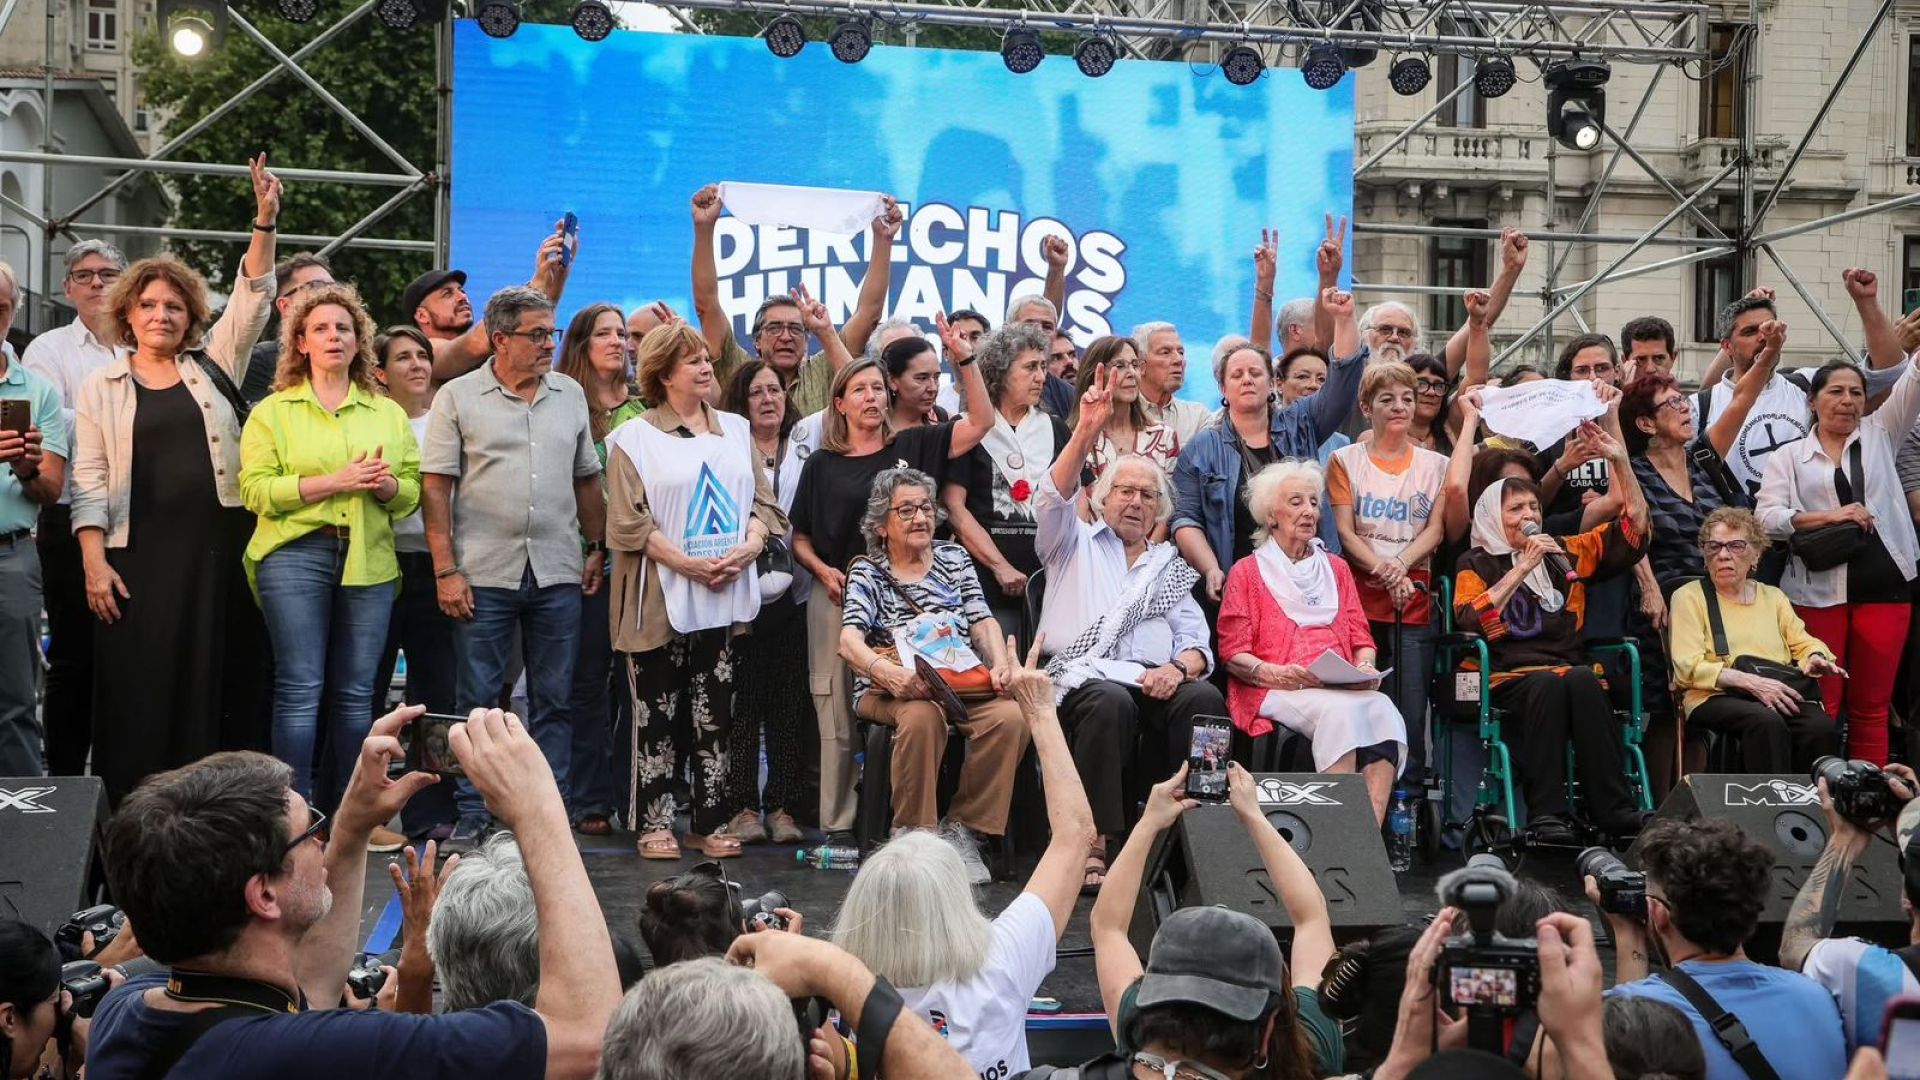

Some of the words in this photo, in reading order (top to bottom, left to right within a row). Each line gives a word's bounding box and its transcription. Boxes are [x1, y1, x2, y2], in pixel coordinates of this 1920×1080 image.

[714, 203, 1125, 293] DERECHOS
[1570, 479, 1594, 488] CABA
[1600, 479, 1609, 487] G
[980, 1059, 1009, 1080] OS
